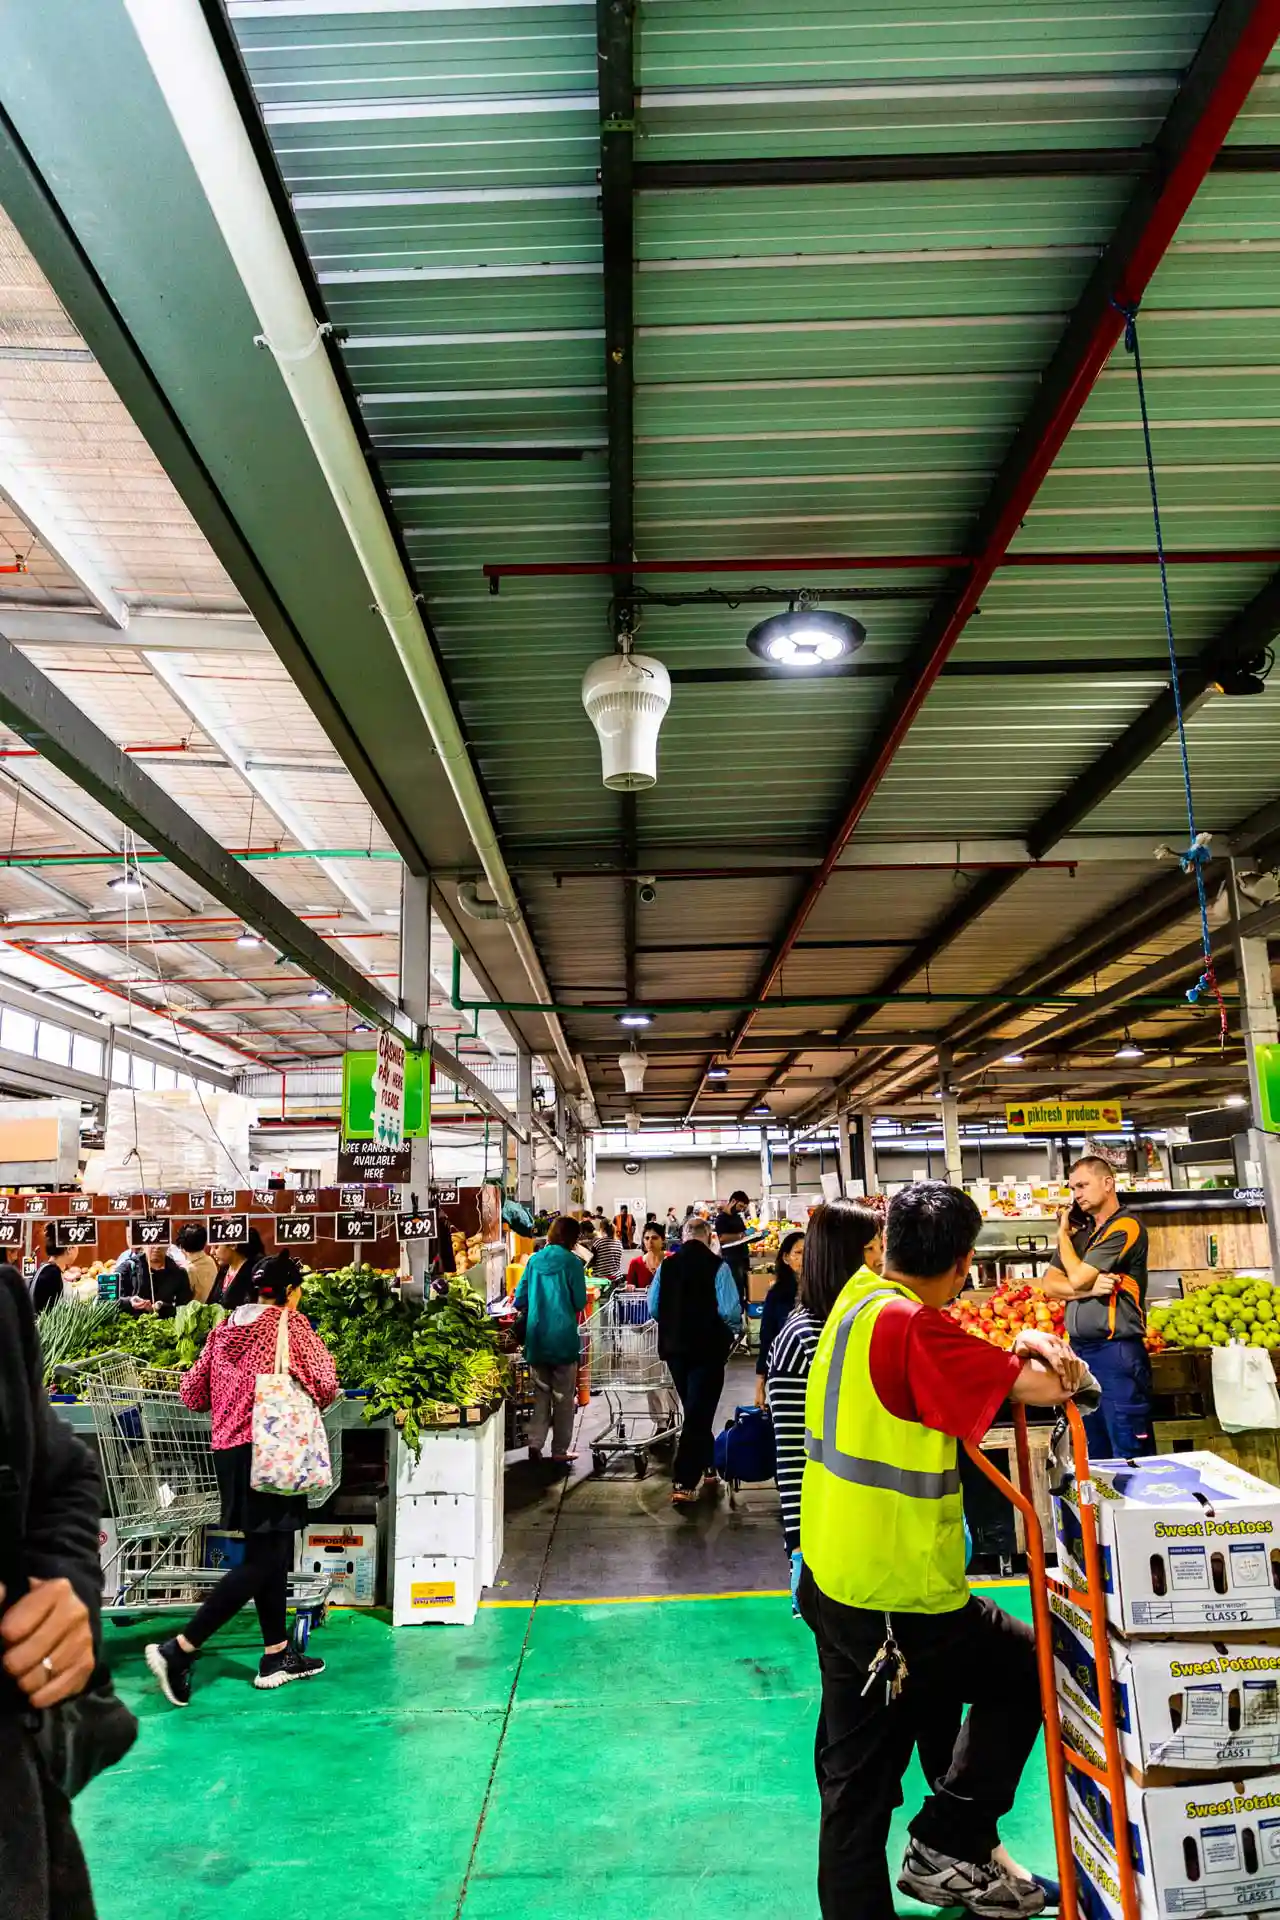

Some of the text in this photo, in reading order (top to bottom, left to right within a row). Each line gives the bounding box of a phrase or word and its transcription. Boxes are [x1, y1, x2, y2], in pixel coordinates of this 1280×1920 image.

[1065, 1104, 1100, 1124] produce
[352, 1155, 397, 1166] AVAILABLE
[363, 1168, 385, 1179] HERE
[1154, 1520, 1274, 1538] Sweet Potatoes
[1205, 1611, 1237, 1621] CLASS
[1170, 1661, 1218, 1678] Sweet
[1216, 1748, 1251, 1759] CLASS 1
[1185, 1800, 1233, 1819] Sweet
[1237, 1890, 1267, 1904] CLASS
